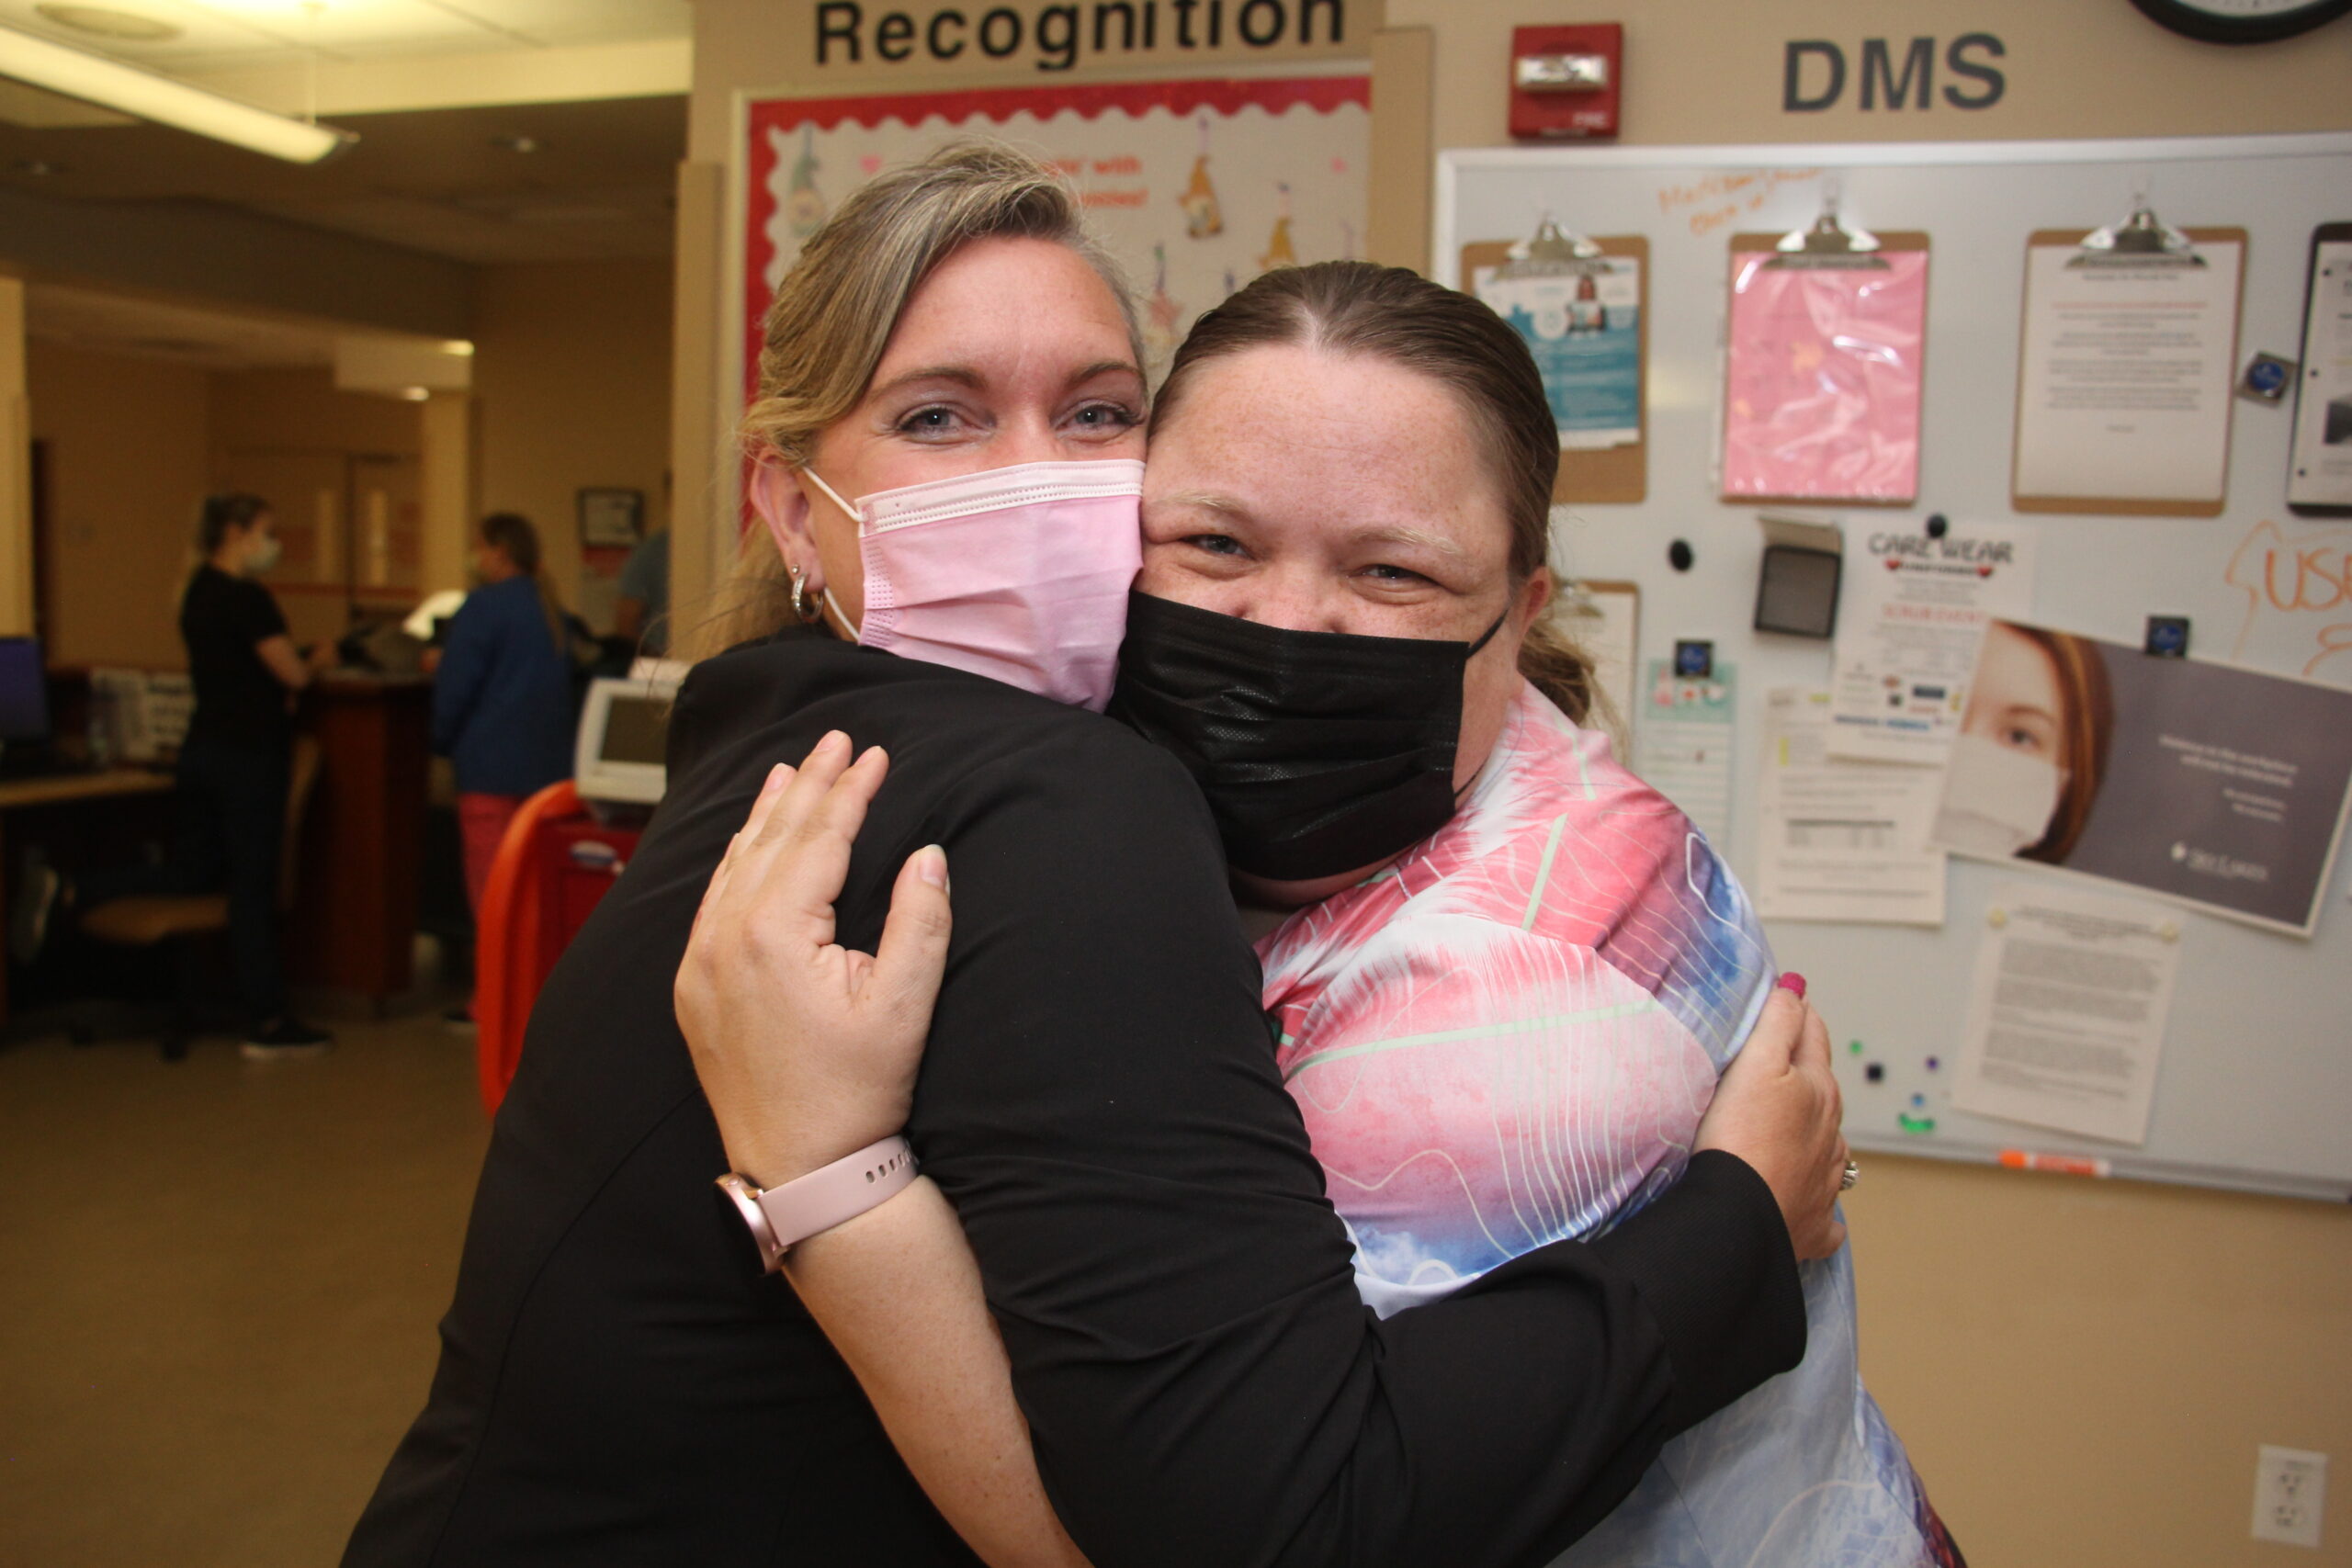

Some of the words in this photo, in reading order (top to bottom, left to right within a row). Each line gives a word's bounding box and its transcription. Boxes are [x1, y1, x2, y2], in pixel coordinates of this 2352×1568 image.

[817, 0, 1344, 71] Recognition
[1783, 31, 2007, 113] DMS
[1868, 533, 1931, 558] CARE
[1941, 538, 2014, 564] WEAR
[2265, 548, 2352, 613] US
